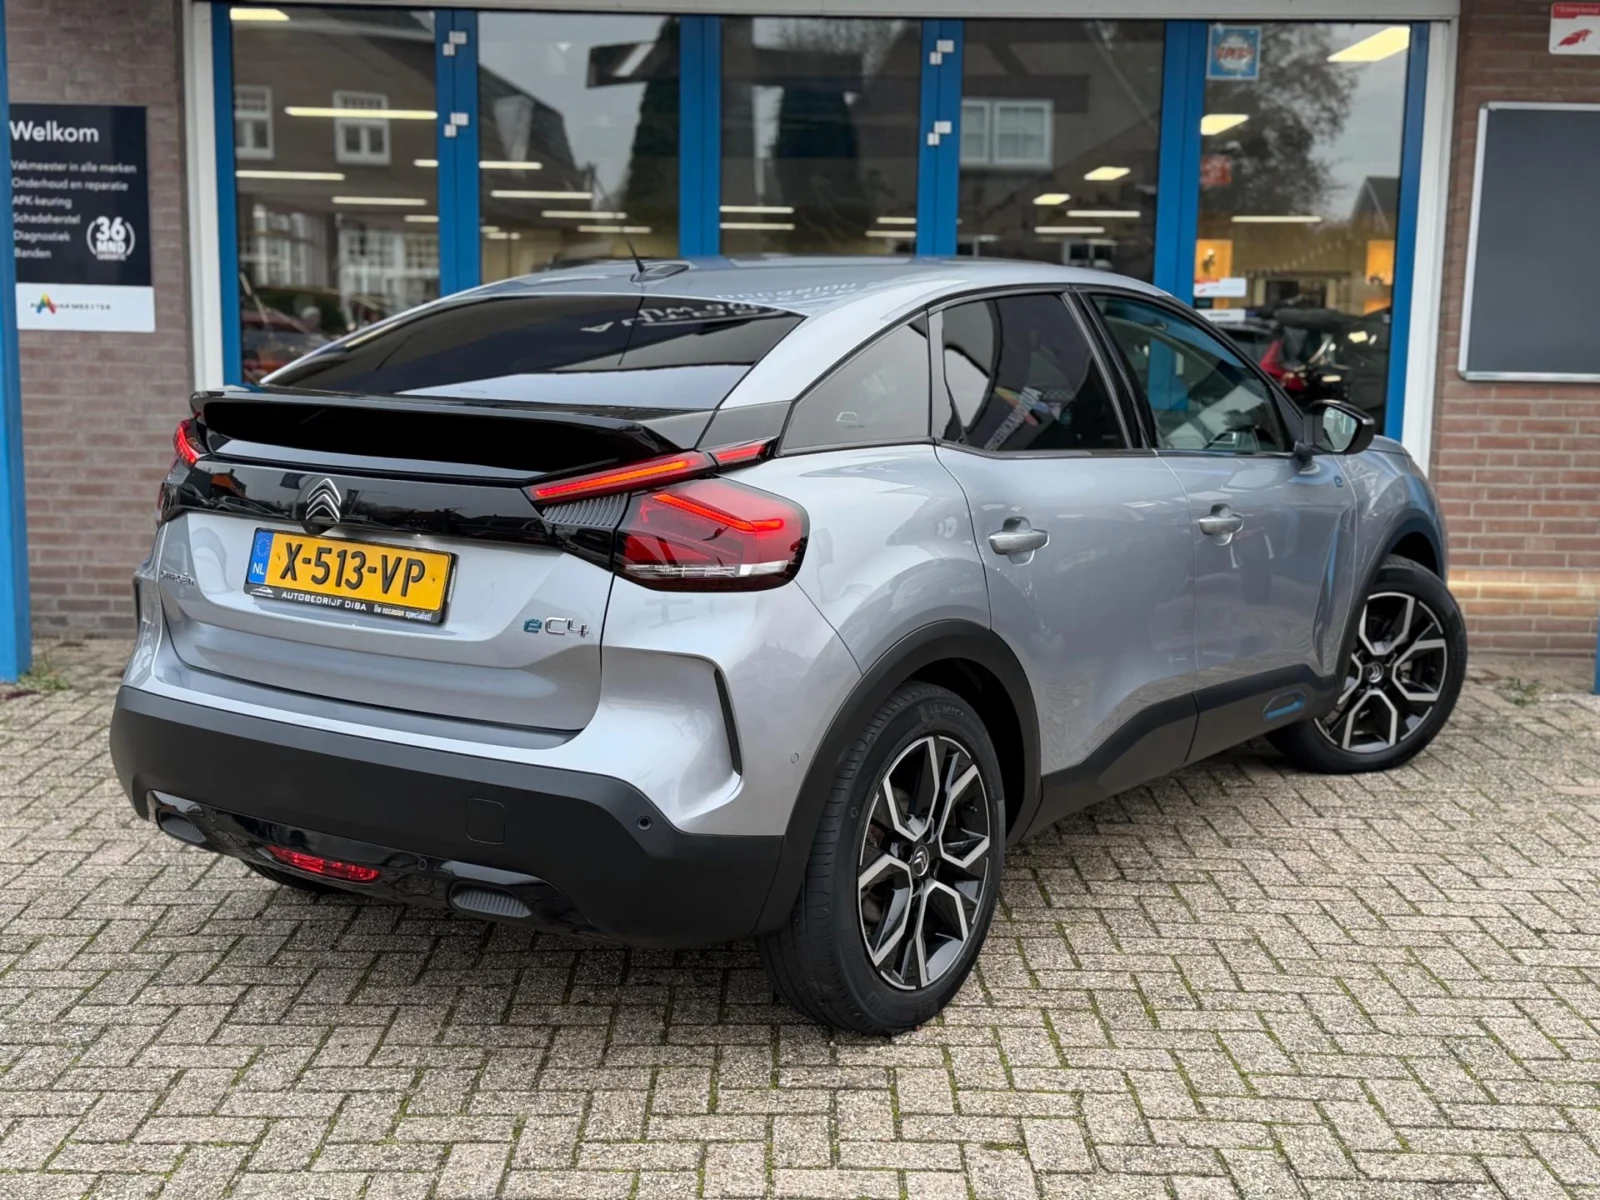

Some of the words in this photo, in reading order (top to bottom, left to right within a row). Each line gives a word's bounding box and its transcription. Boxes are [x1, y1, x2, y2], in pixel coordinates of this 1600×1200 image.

[9, 120, 99, 142] Welkom
[11, 160, 67, 172] Vakmeester
[69, 162, 78, 172] in
[80, 162, 97, 173] alle
[99, 163, 137, 174] merken
[11, 177, 68, 190] Onderhoud
[70, 181, 82, 190] en
[84, 181, 129, 193] reparatie
[12, 212, 81, 225] Schadeherstel
[95, 216, 126, 241] 36
[13, 229, 71, 244] Diagnostiek
[14, 246, 52, 259] Banden
[96, 241, 126, 253] MND
[252, 562, 265, 575] NL
[279, 542, 426, 597] X-513-VP
[281, 591, 342, 606] AUTOBEDRIJF
[344, 600, 367, 611] DIBA
[373, 604, 382, 613] Uw
[382, 607, 404, 617] occasion
